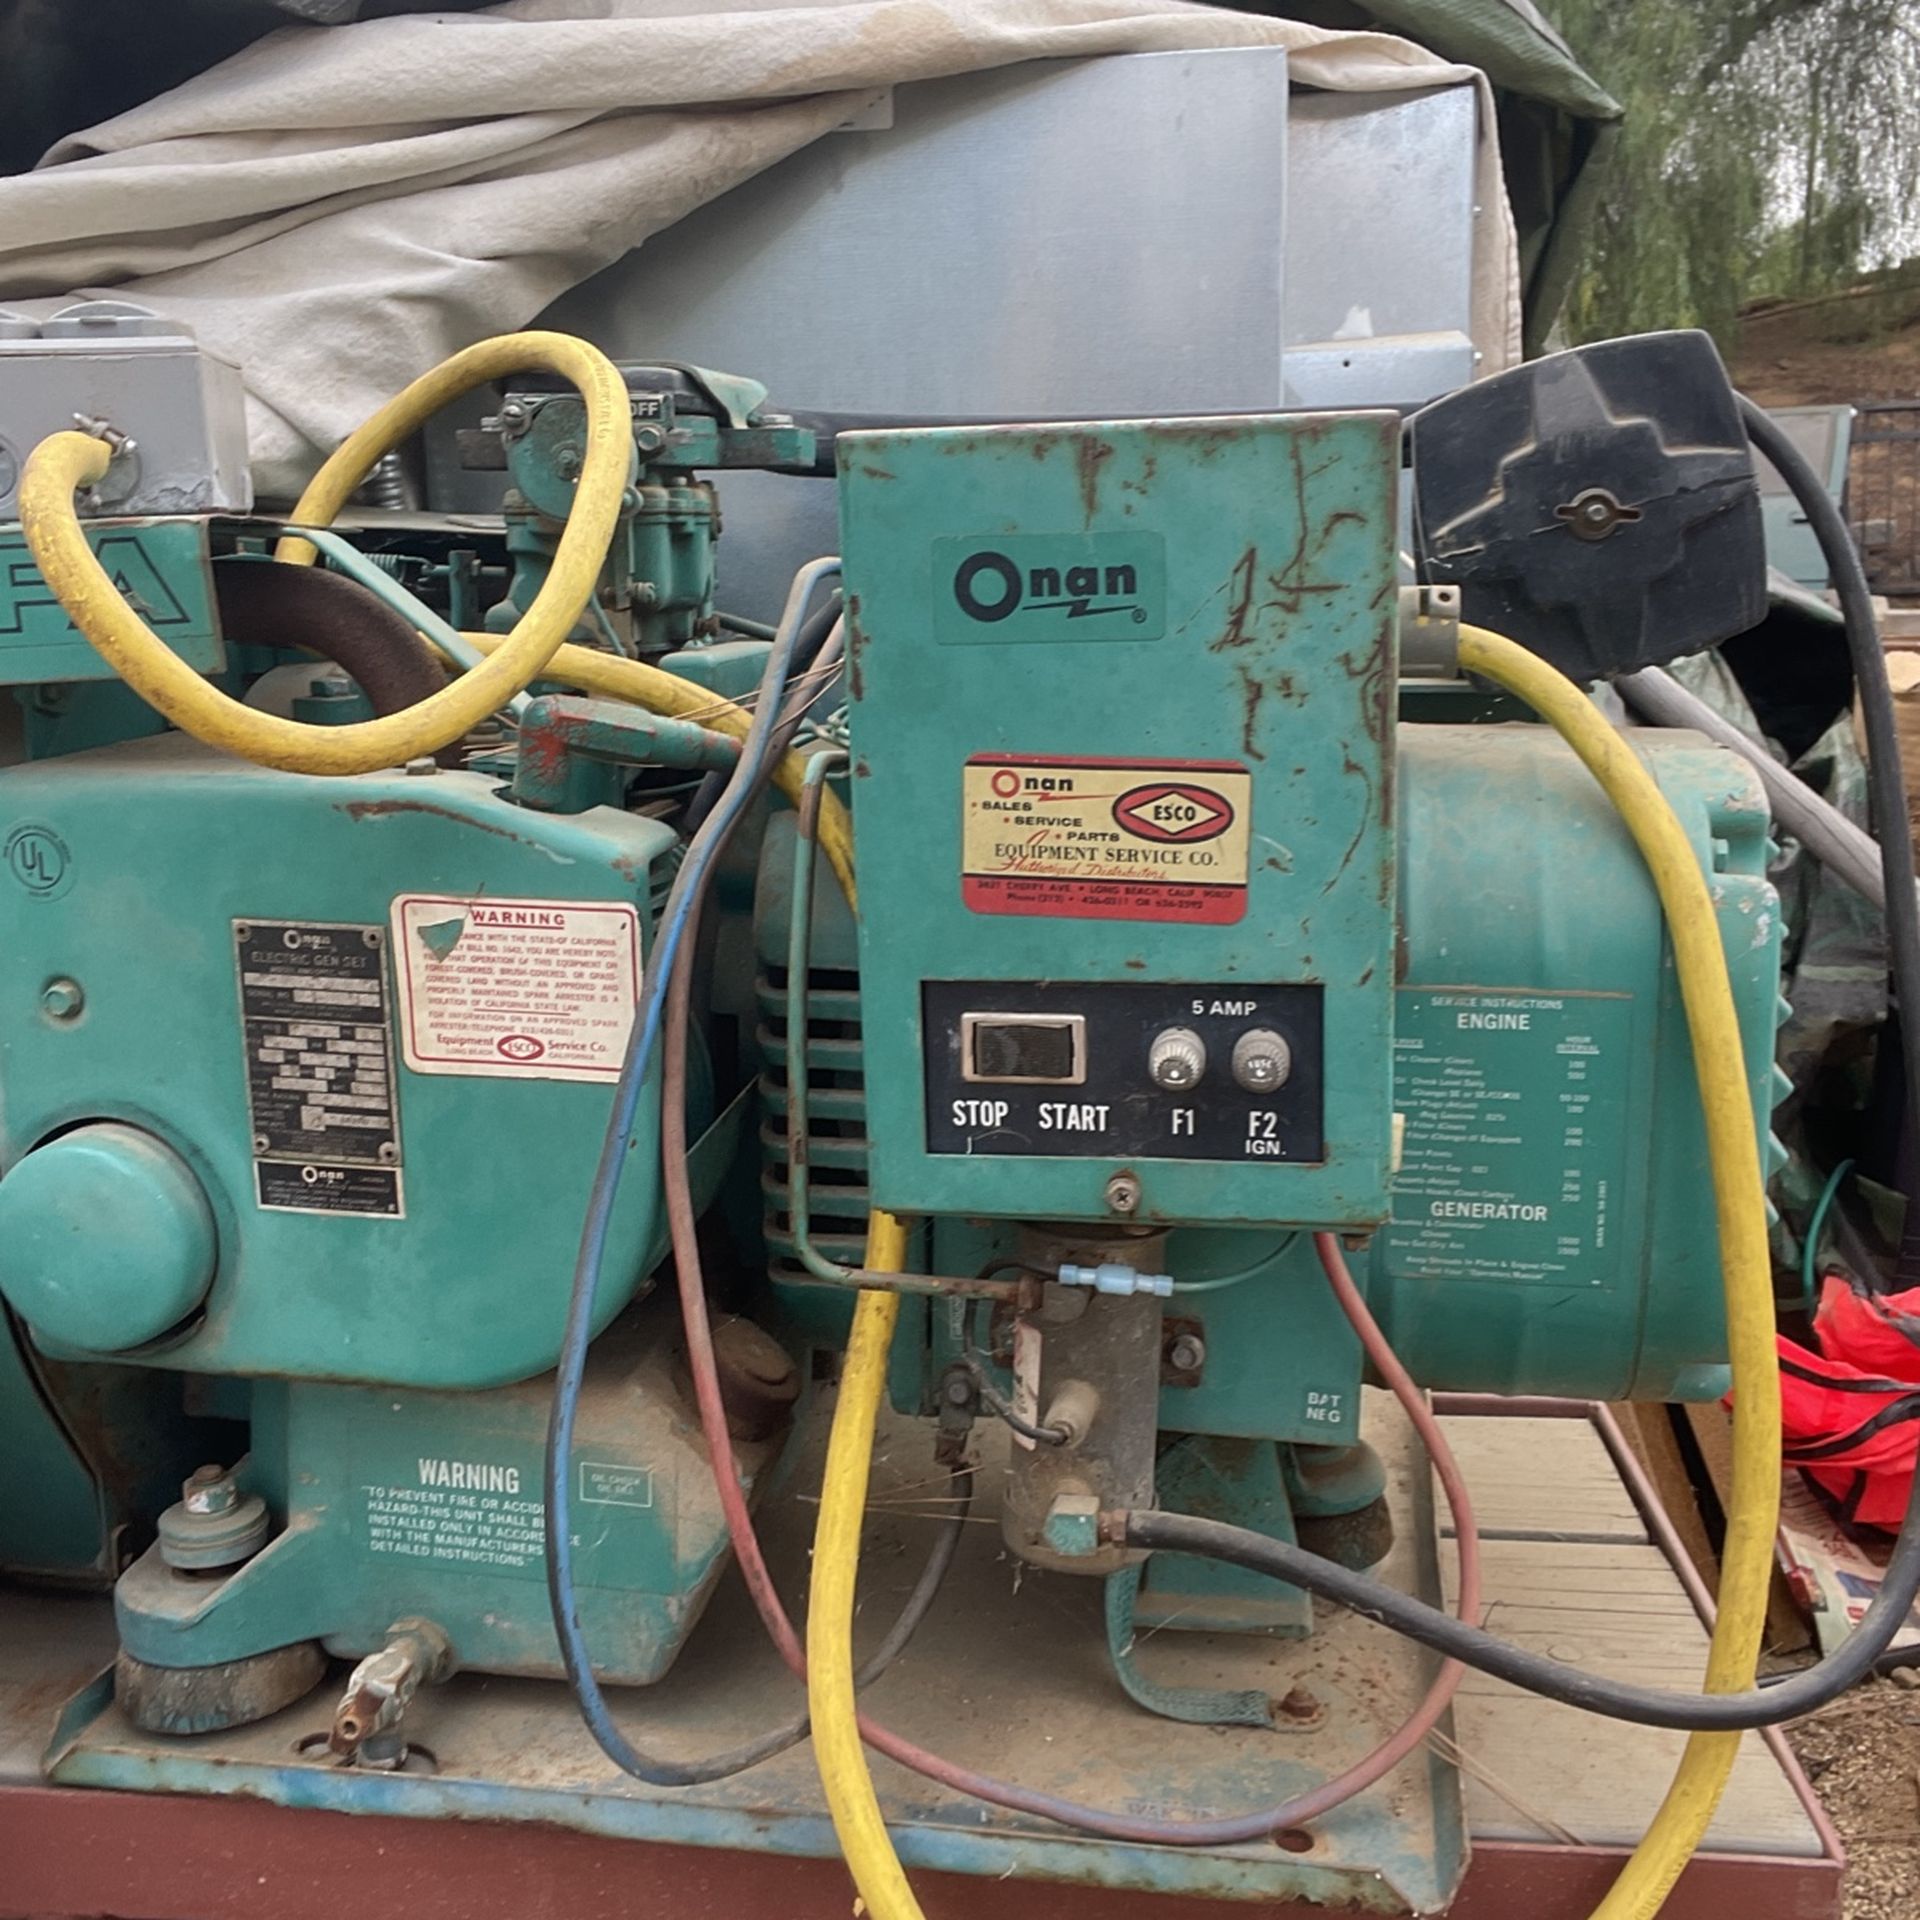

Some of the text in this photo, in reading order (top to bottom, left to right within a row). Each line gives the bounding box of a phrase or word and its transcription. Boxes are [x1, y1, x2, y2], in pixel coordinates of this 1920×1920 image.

[954, 550, 1136, 623] Onan
[991, 770, 1073, 798] Onan
[982, 801, 1032, 811] SALES
[1153, 805, 1196, 822] ESCO
[1014, 816, 1082, 827] SERVICE
[1067, 832, 1120, 842] PARTS
[20, 841, 53, 881] UL
[995, 844, 1218, 866] EQUIPMENT SERVICE CO.
[1090, 886, 1119, 895] LONG
[471, 910, 565, 925] WARNING
[571, 937, 616, 946] CALIFORNIA
[471, 955, 515, 963] OPERATION
[556, 960, 601, 968] EQUIPMENT
[1192, 1000, 1257, 1016] 5 AMP
[1431, 997, 1563, 1009] SERVICE INSTRUCTIONS
[1457, 1013, 1531, 1030] ENGINE
[437, 1033, 494, 1046] Equipment
[548, 1040, 587, 1050] Service
[953, 1101, 1277, 1138] STOP START F1 F2
[1245, 1140, 1287, 1155] IGN.
[1430, 1201, 1547, 1221] GENERATOR
[1307, 1392, 1342, 1407] BAT
[1306, 1407, 1341, 1423] NEG
[418, 1458, 519, 1494] WARNING
[388, 1487, 445, 1504] PREVENT
[449, 1494, 476, 1507] FIRE
[481, 1498, 499, 1509] OR
[368, 1514, 436, 1531] INSTALLED
[440, 1520, 473, 1534] ONLY
[478, 1525, 491, 1536] IN
[454, 1509, 483, 1522] UNIT
[488, 1512, 528, 1527] SHALL
[370, 1527, 402, 1540] WITH
[406, 1530, 430, 1543] THE
[370, 1540, 430, 1556] DETAILED
